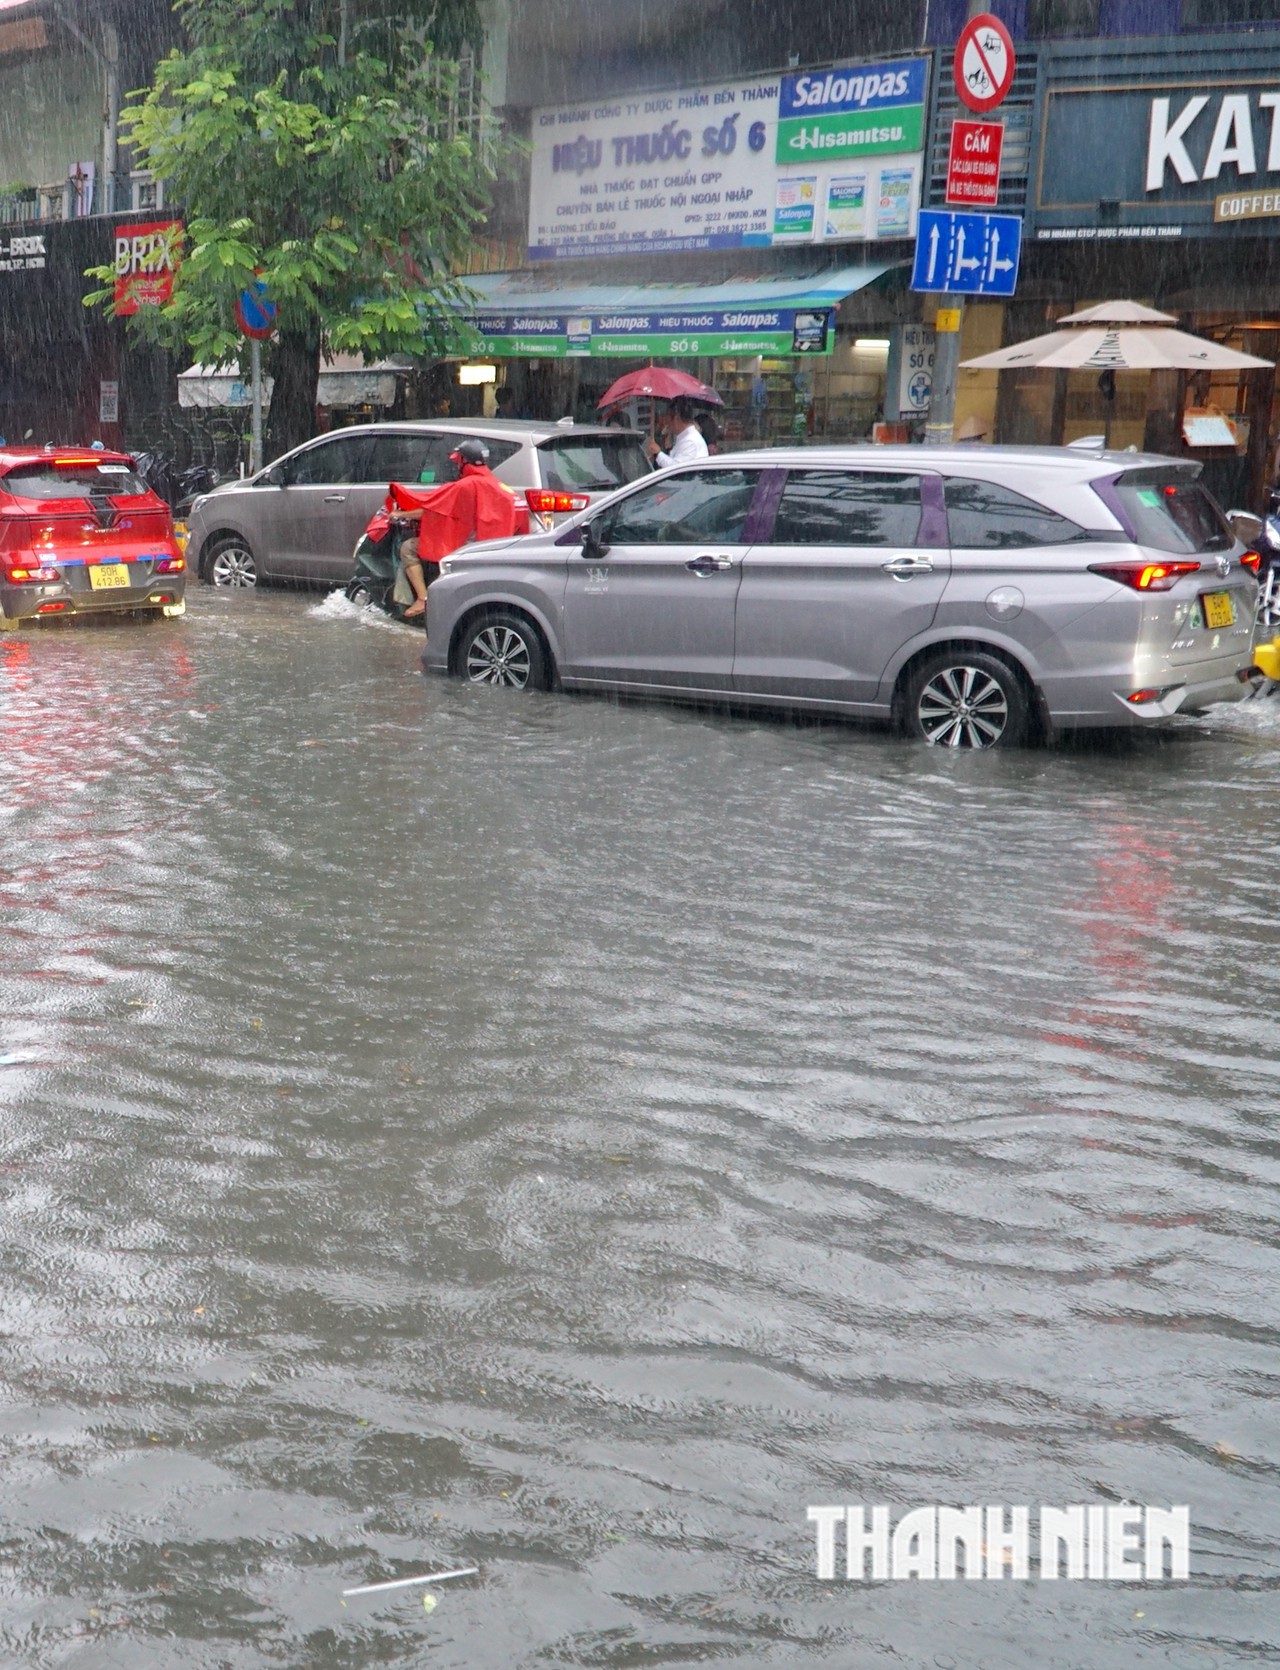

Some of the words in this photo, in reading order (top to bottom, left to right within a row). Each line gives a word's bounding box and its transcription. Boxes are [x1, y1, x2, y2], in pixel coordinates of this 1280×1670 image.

[792, 69, 910, 108] Salonpas
[539, 114, 555, 127] CHI
[594, 103, 621, 118] CÔNG
[626, 104, 639, 116] TY
[644, 99, 673, 114] DƯỢC
[678, 86, 709, 109] PHẨM
[713, 86, 736, 105] BẾN
[741, 85, 779, 101] THÀNH
[552, 133, 603, 176] HIỆU
[612, 119, 693, 167] THUỐC
[701, 111, 741, 157] SỐ
[748, 120, 767, 152] 6
[789, 126, 903, 150] Hisamitsu
[964, 127, 990, 153] CẤM
[604, 176, 635, 194] THUỐC
[664, 172, 696, 187] CHUẨN
[701, 172, 722, 185] GPP
[556, 199, 592, 217] CHUYÊN
[596, 196, 615, 213] BÁN
[634, 193, 666, 208] THUỐC
[670, 191, 687, 207] NỘI
[691, 191, 721, 206] NGOẠI
[725, 188, 754, 204] NHẬP
[779, 208, 812, 220] Salonpas
[115, 234, 174, 275] BRIX
[481, 319, 506, 329] THUỐC
[512, 318, 559, 332] Salonpas
[599, 316, 649, 331] Salonpas
[682, 316, 714, 327] THUỐC
[721, 313, 779, 329] Salonpas
[471, 341, 486, 353] SỐ
[488, 342, 495, 353] 6
[670, 338, 688, 353] SỐ
[691, 341, 699, 352] 6
[910, 348, 926, 369] SỐ
[928, 354, 935, 368] 6
[96, 575, 126, 587] 412.86
[100, 566, 118, 577] 50H
